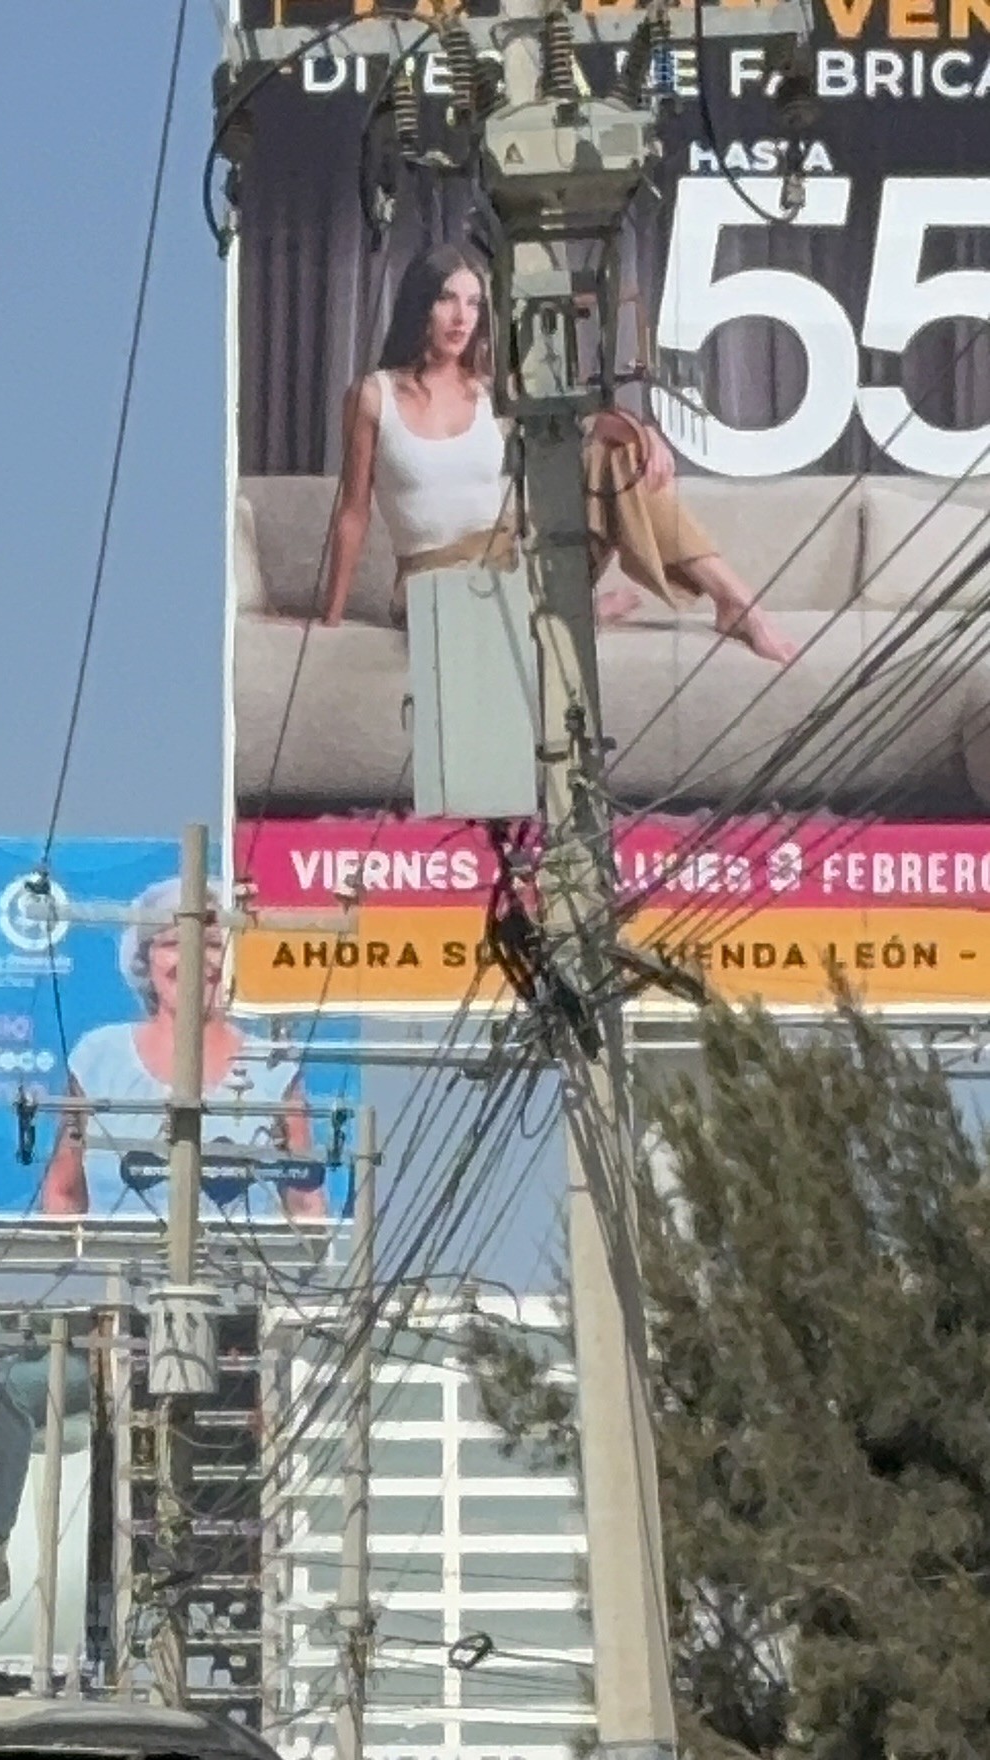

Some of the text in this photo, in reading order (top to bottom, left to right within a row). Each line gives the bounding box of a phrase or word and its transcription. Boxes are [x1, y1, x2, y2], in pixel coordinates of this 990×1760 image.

[729, 49, 990, 97] FBRIC
[289, 849, 479, 890] VIERNES
[271, 941, 422, 968] AHORA
[828, 935, 939, 969] LEÓN
